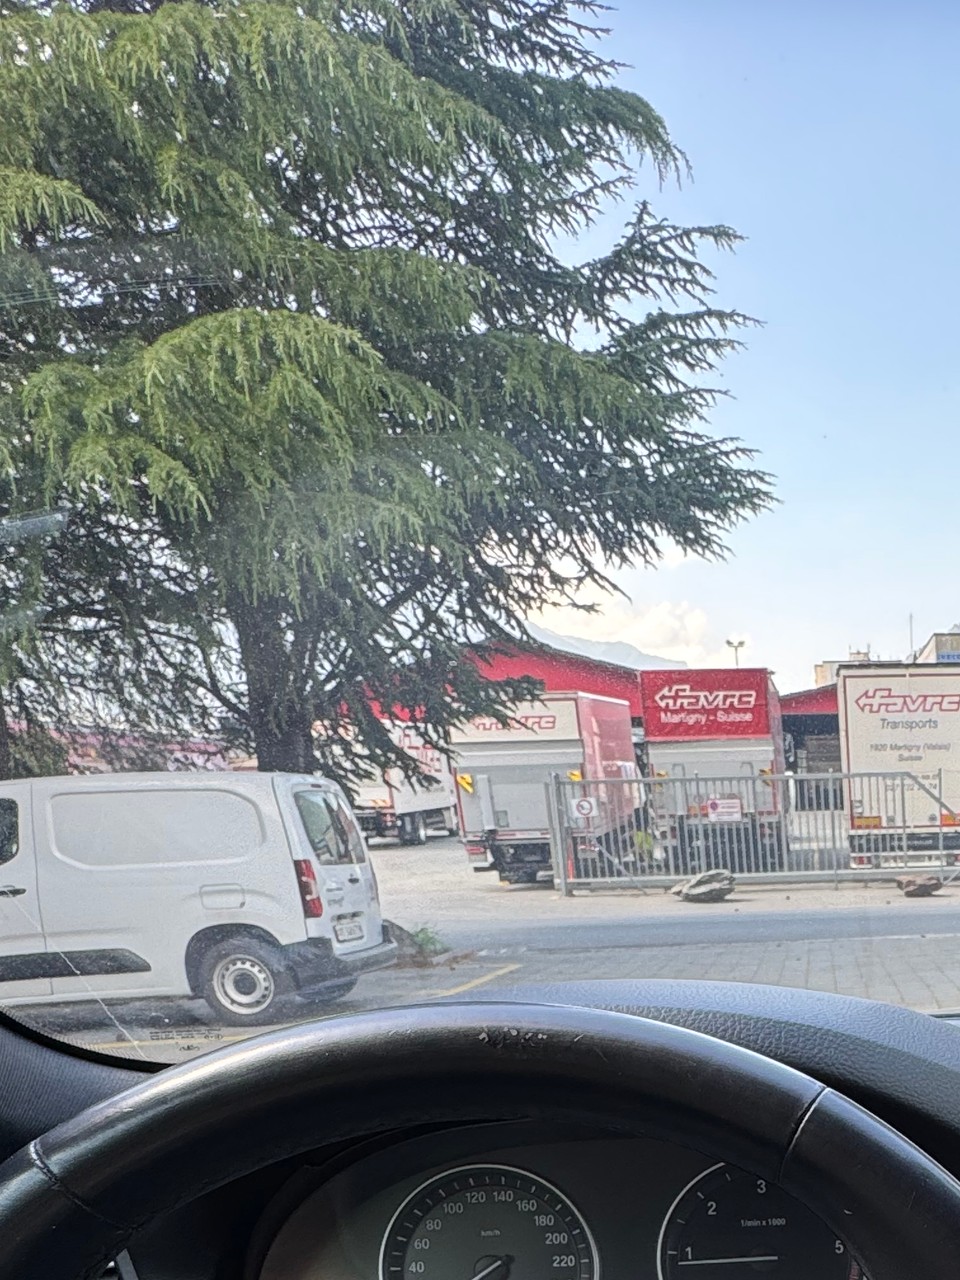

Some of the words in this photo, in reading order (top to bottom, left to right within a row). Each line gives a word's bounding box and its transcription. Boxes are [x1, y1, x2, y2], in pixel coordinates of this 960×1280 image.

[660, 710, 708, 725] Martigny
[716, 710, 753, 722] Suisse
[880, 718, 939, 732] Transports
[756, 1179, 767, 1194] 3
[465, 1191, 486, 1203] 120
[492, 1190, 514, 1202] 140
[443, 1202, 464, 1214] 100
[515, 1199, 537, 1212] 160
[707, 1201, 717, 1216] 2
[425, 1219, 442, 1231] 80
[533, 1214, 555, 1226] 180
[768, 1217, 786, 1227] 1000
[414, 1238, 430, 1250] 60
[544, 1232, 568, 1245] 200
[685, 1246, 693, 1260] 1
[834, 1240, 845, 1254] 5
[408, 1261, 425, 1273] 40
[552, 1255, 576, 1268] 220
